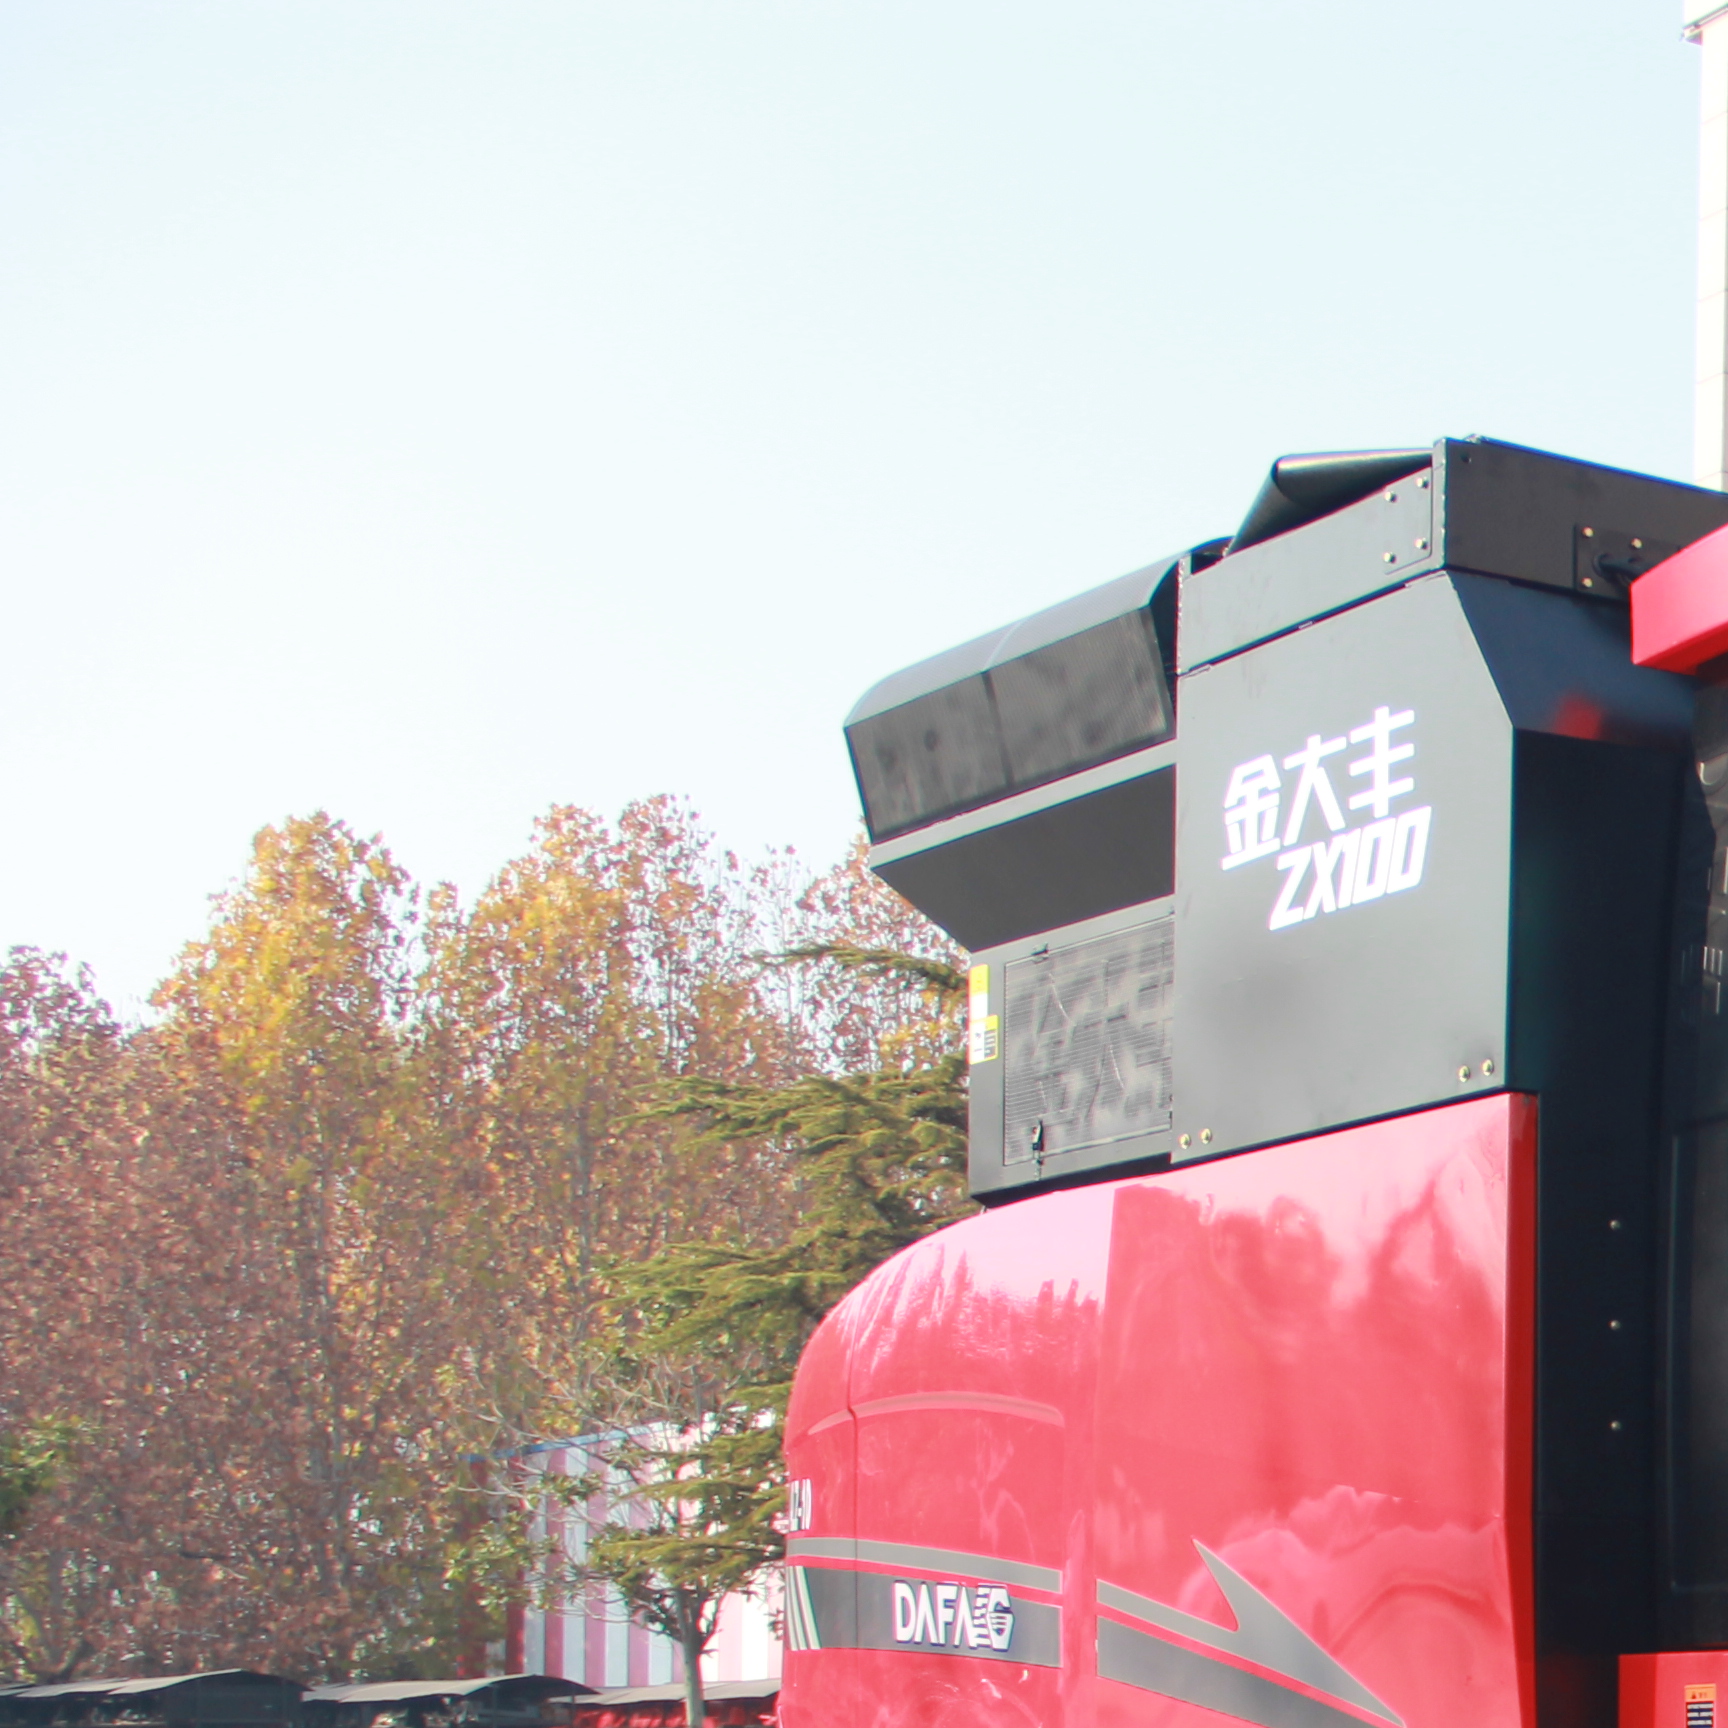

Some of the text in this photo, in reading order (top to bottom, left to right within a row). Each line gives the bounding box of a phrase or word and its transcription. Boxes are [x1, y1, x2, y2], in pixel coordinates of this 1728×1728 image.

[1220, 705, 1415, 871] 金大丰
[1268, 805, 1432, 931] ZX100
